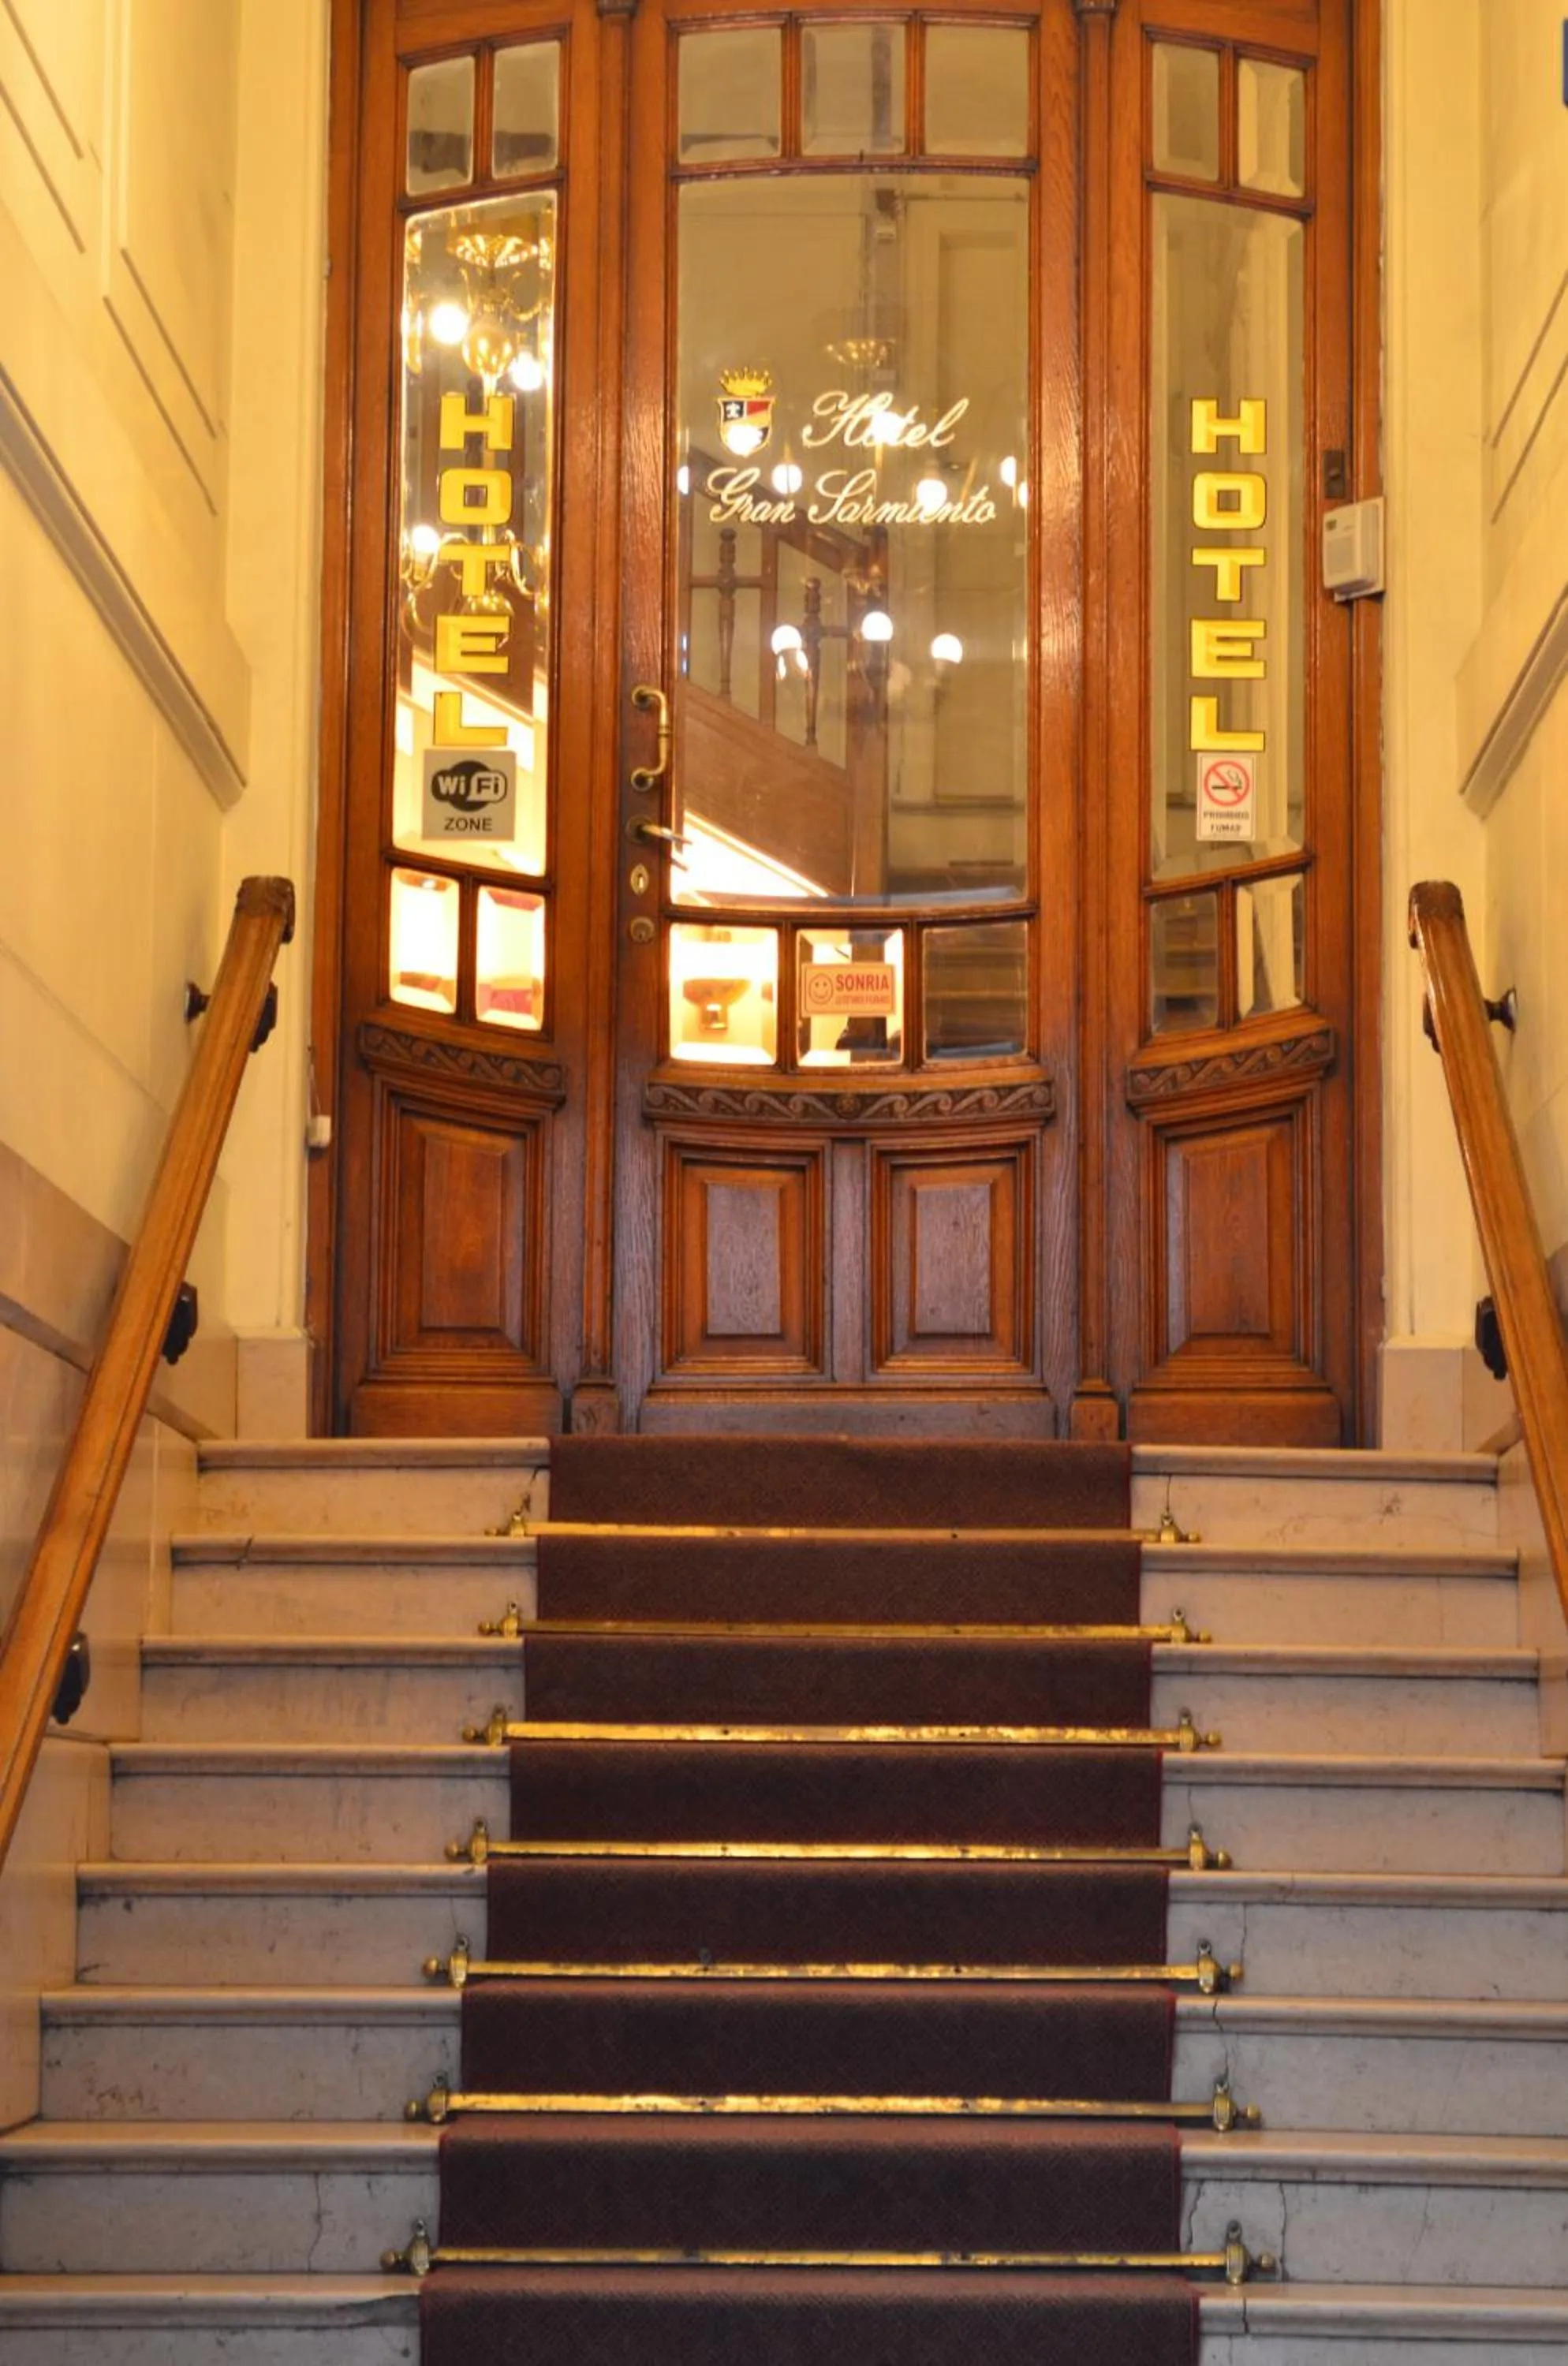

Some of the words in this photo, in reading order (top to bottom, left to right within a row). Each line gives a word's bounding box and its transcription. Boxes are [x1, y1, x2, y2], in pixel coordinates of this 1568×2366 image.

[707, 467, 796, 523] Gran
[433, 394, 513, 746] HOTEL
[1189, 398, 1265, 752] HOTEL
[444, 817, 493, 831] ZONE
[835, 973, 890, 992] SONRIA
